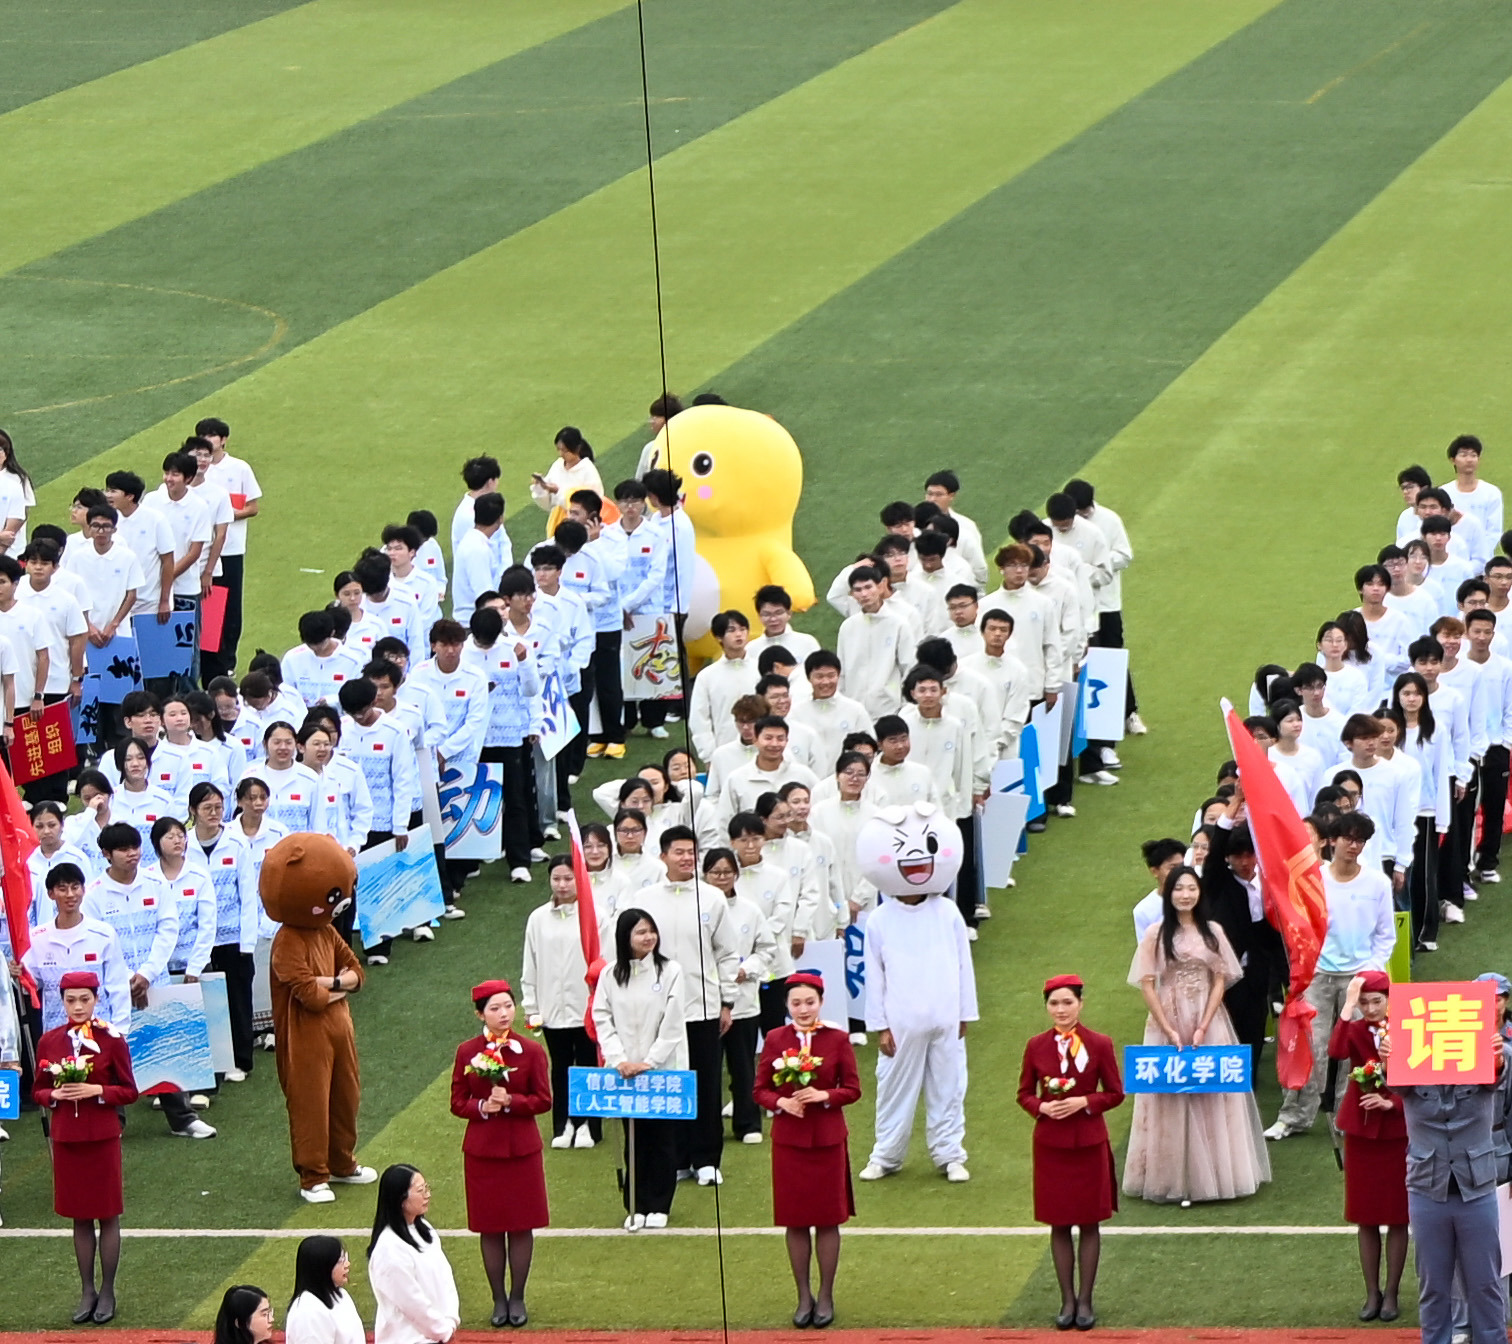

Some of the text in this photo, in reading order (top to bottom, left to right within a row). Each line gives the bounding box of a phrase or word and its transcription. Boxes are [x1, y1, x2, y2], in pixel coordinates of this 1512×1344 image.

[1401, 994, 1484, 1072] 请
[586, 1072, 682, 1093] 信息工程学院
[1135, 1056, 1245, 1084] 环化学院
